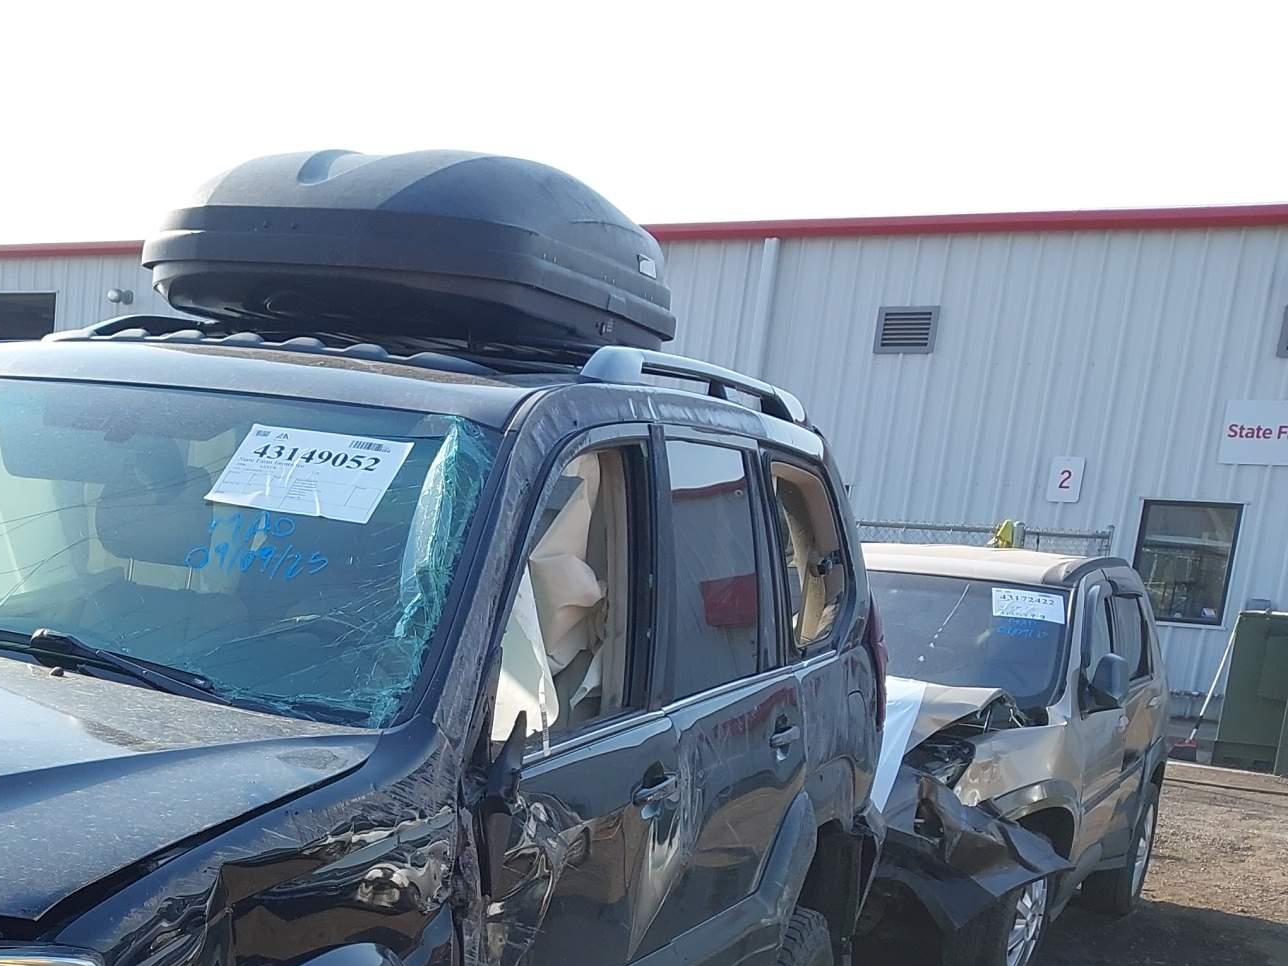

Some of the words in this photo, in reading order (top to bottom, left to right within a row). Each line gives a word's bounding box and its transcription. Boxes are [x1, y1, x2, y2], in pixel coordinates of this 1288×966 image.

[1227, 423, 1273, 440] State
[253, 443, 381, 472] 43149052
[1058, 469, 1073, 490] 2
